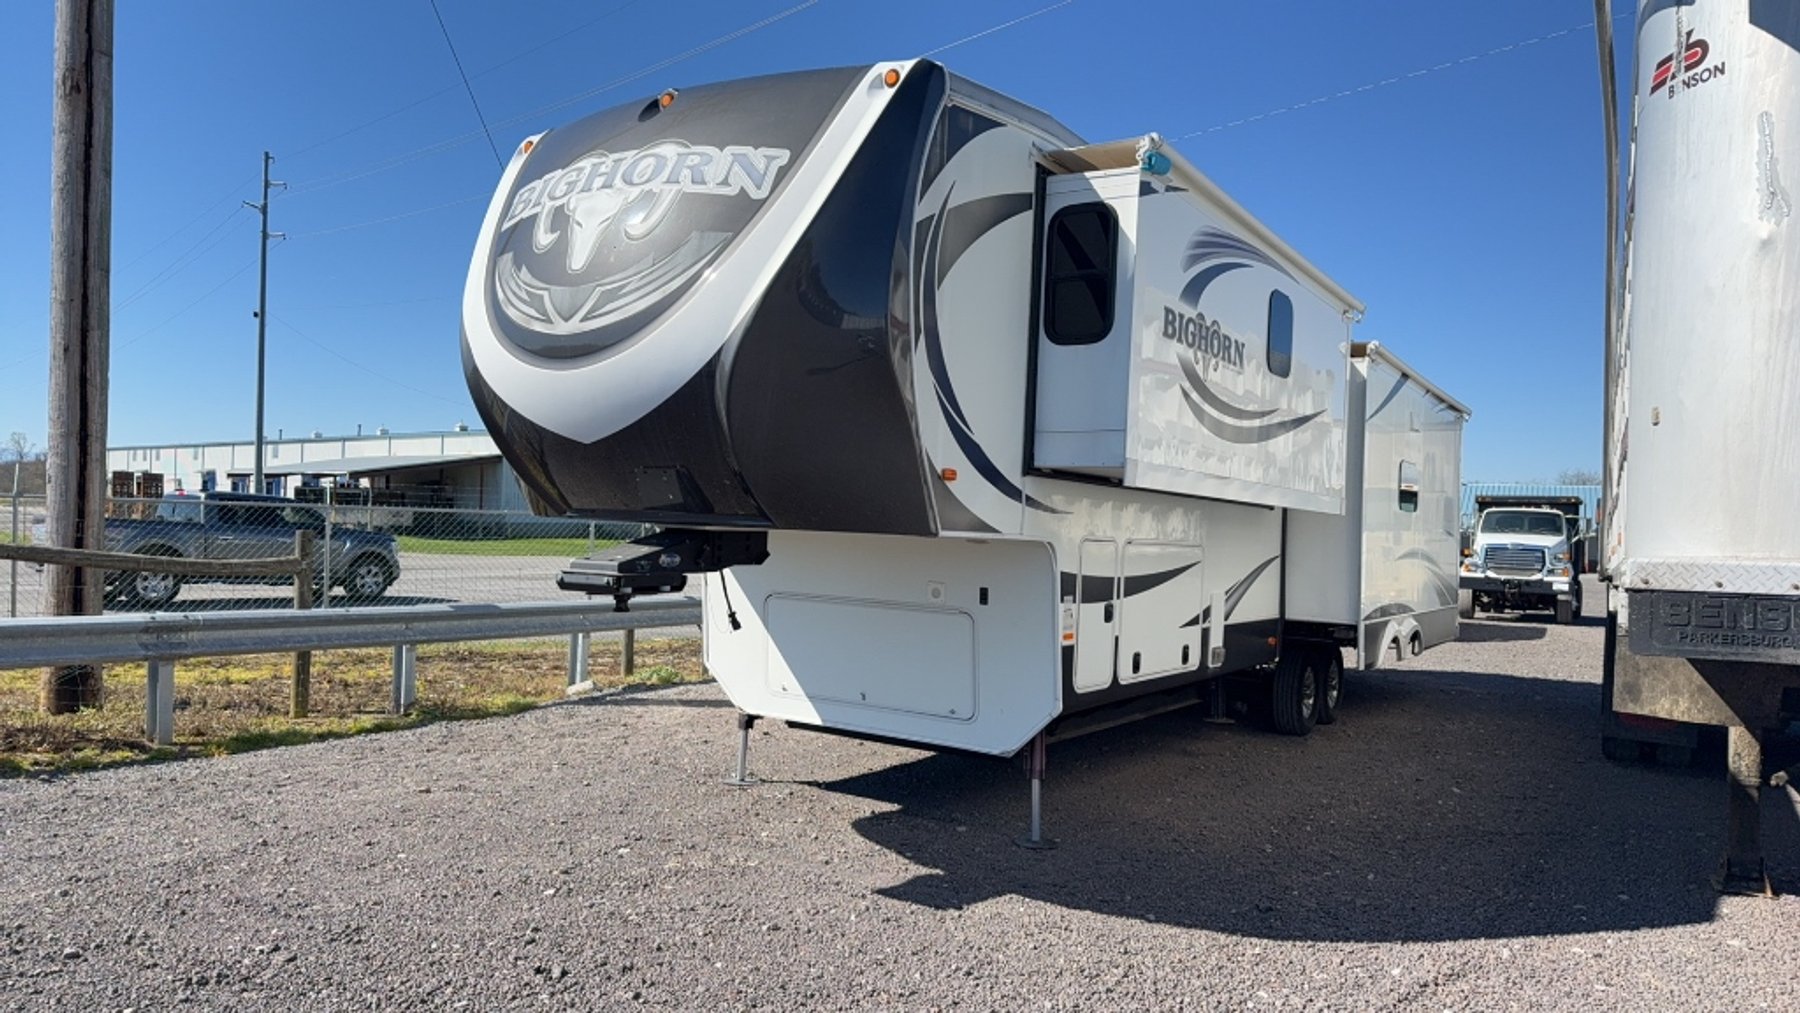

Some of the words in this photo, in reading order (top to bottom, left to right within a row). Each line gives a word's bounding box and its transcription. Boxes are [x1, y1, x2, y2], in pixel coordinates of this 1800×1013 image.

[1667, 61, 1726, 100] BNSON
[502, 148, 788, 224] BIGHORN
[1162, 304, 1246, 371] BIGHORN
